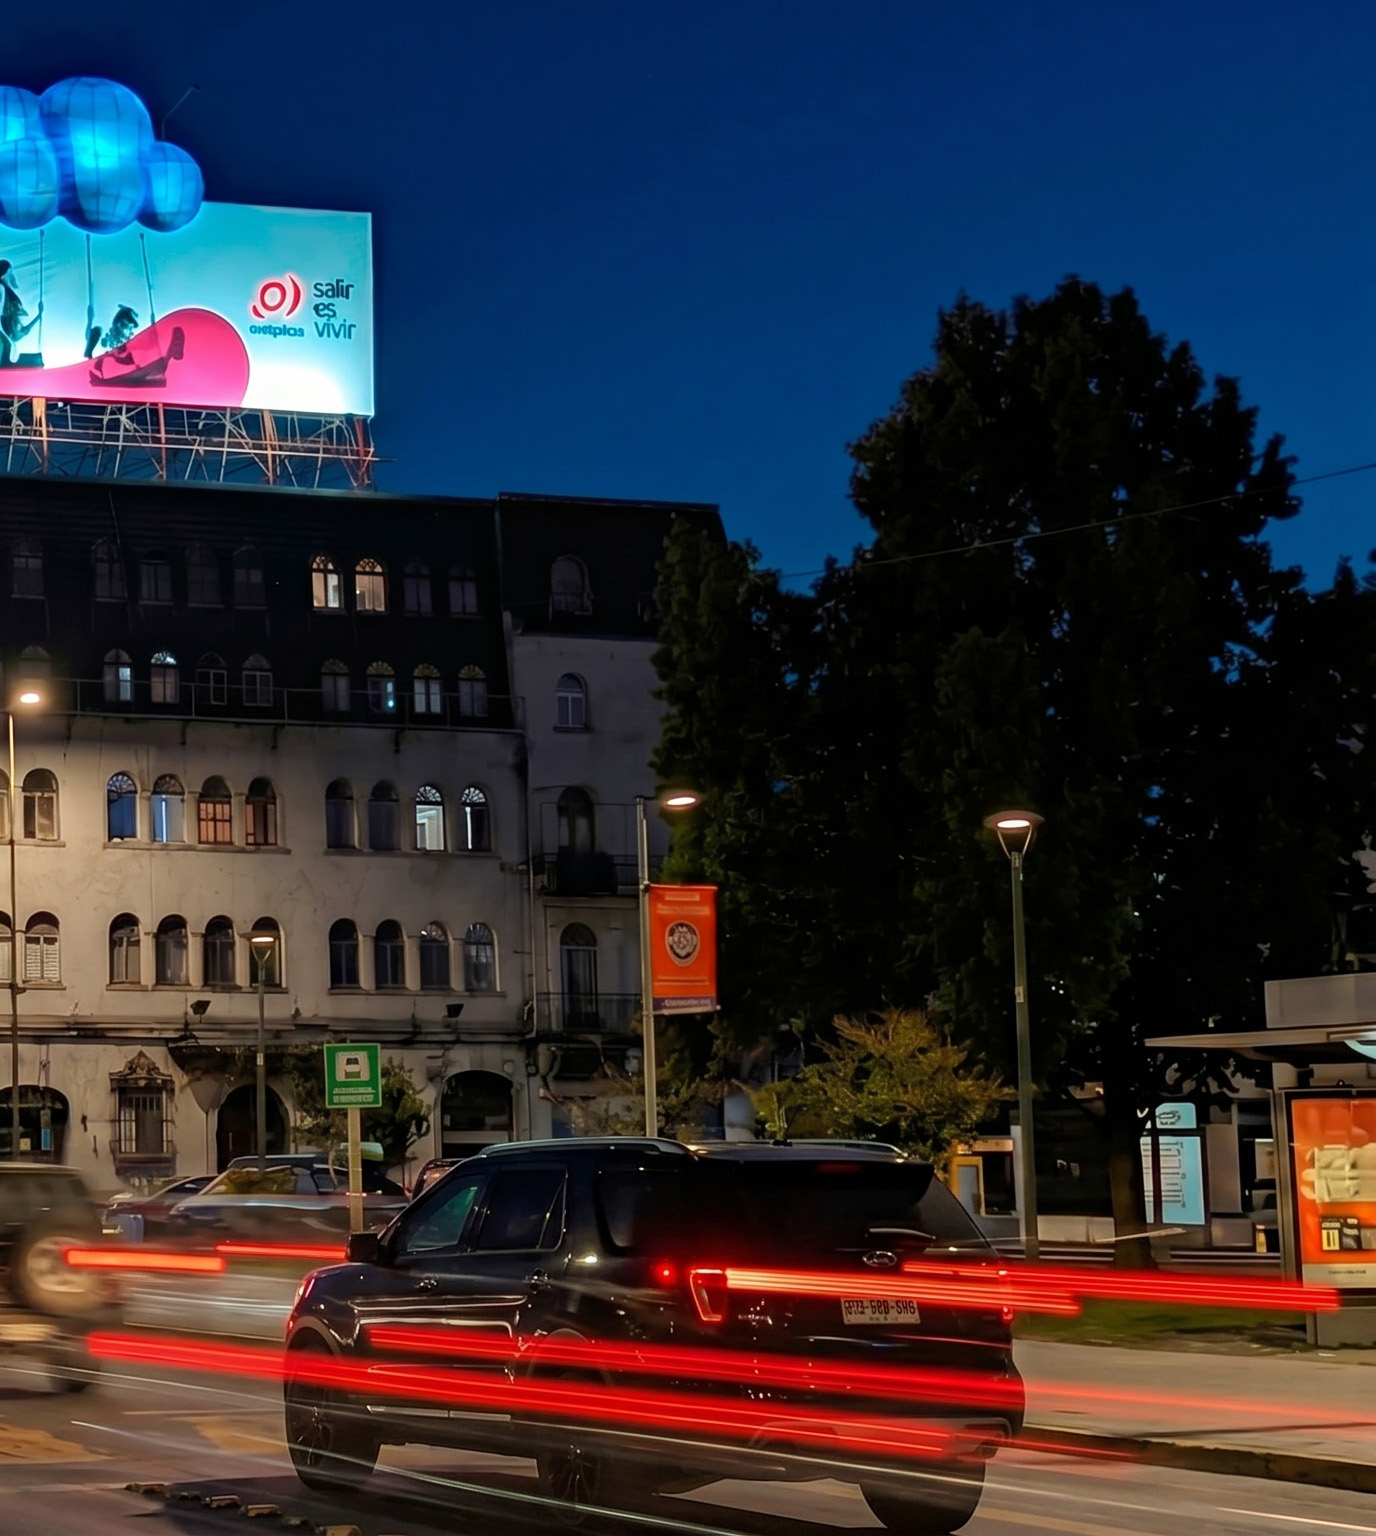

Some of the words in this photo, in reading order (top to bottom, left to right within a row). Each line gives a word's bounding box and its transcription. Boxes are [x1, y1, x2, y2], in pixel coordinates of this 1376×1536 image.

[313, 279, 355, 300] salir
[312, 302, 337, 319] es
[313, 317, 357, 340] vivir
